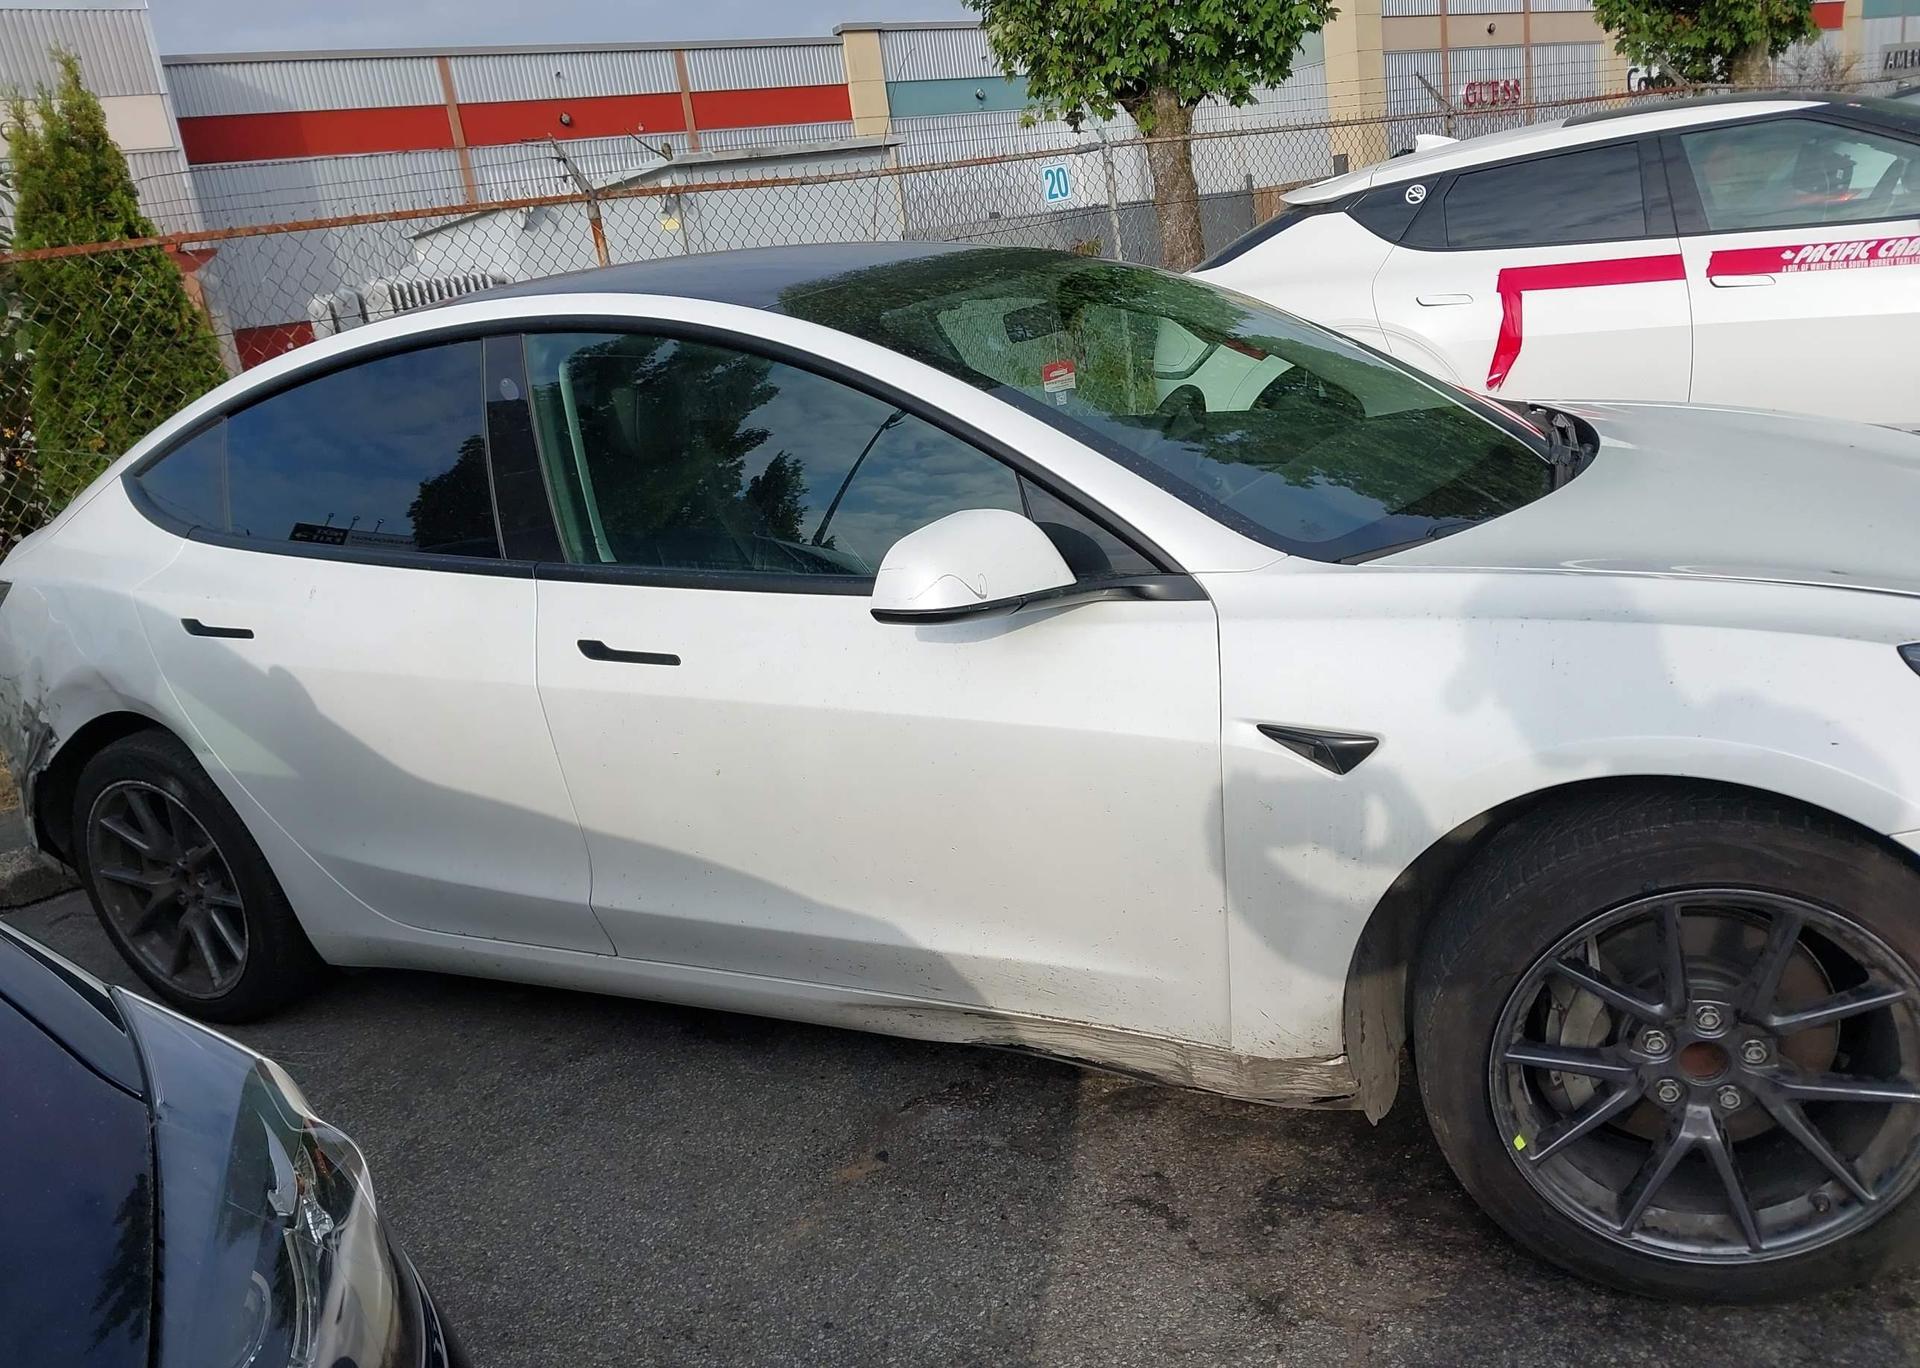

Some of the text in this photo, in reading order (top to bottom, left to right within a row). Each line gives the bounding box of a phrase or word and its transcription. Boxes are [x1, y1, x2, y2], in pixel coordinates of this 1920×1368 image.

[1884, 49, 1920, 70] AMER
[1464, 79, 1520, 106] GUESS
[1045, 168, 1069, 199] 20
[1793, 237, 1920, 263] PACIFIC CAB
[1810, 262, 1829, 271] WHITE
[1831, 261, 1847, 270] ROCK
[1848, 259, 1868, 269] SOUTH
